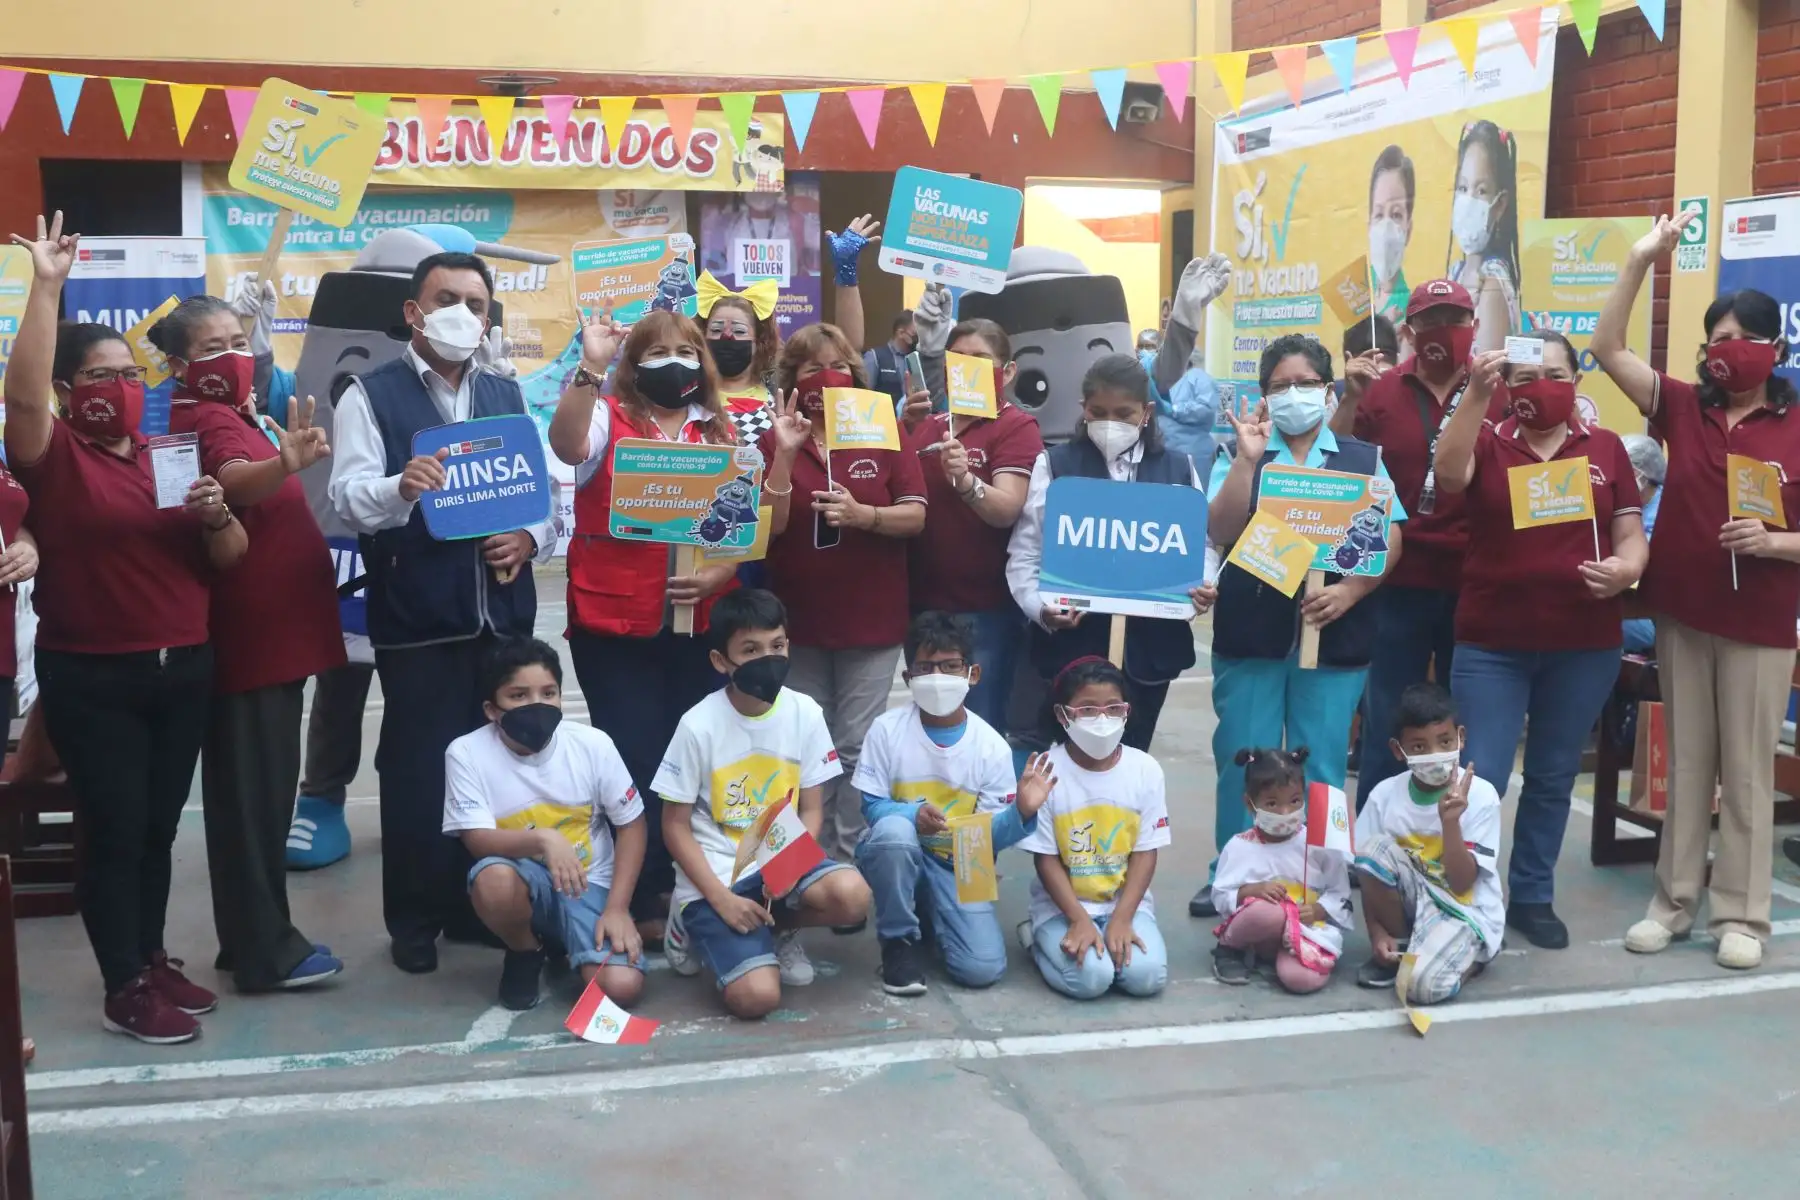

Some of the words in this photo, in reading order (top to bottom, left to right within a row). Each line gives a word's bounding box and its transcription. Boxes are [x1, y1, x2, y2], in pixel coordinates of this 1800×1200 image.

[261, 117, 305, 162] Sí,
[252, 151, 281, 172] me
[250, 169, 282, 188] Protege
[312, 192, 335, 207] niñez
[915, 185, 942, 200] LAS
[227, 207, 314, 227] Barrdo
[358, 204, 491, 225] vacunación
[911, 210, 937, 225] NOS
[914, 196, 989, 225] VACUNAS
[285, 229, 333, 244] ontra
[338, 229, 356, 243] la
[908, 222, 989, 250] ESPERANZA
[578, 252, 607, 262] Barrido
[608, 250, 618, 258] de
[618, 244, 660, 256] vacunación
[742, 244, 784, 262] TODOS
[742, 262, 784, 275] VUELVEN
[619, 274, 632, 284] tu
[580, 282, 655, 303] oportunidad!
[1576, 315, 1598, 332] DE
[1233, 336, 1259, 351] Centro
[621, 452, 655, 463] Barrido
[656, 453, 669, 462] de
[670, 453, 723, 465] vacunación
[671, 462, 706, 471] COVID-19
[436, 453, 534, 492] MINSA
[642, 483, 664, 496] ¡Es
[666, 485, 683, 496] tu
[1267, 477, 1298, 487] Barrido
[1300, 479, 1310, 487] de
[1312, 482, 1359, 492] vacunación
[1312, 488, 1344, 497] COVID-19
[434, 494, 464, 509] DIRIS
[467, 487, 497, 503] LIMA
[499, 481, 537, 498] NORTE
[615, 497, 709, 510] oportunidad!
[1284, 507, 1304, 520] ¡Es
[1307, 509, 1322, 521] tu
[1057, 514, 1188, 556] MINSA
[1288, 522, 1345, 536] tunidad!
[1069, 820, 1096, 854] Sí,
